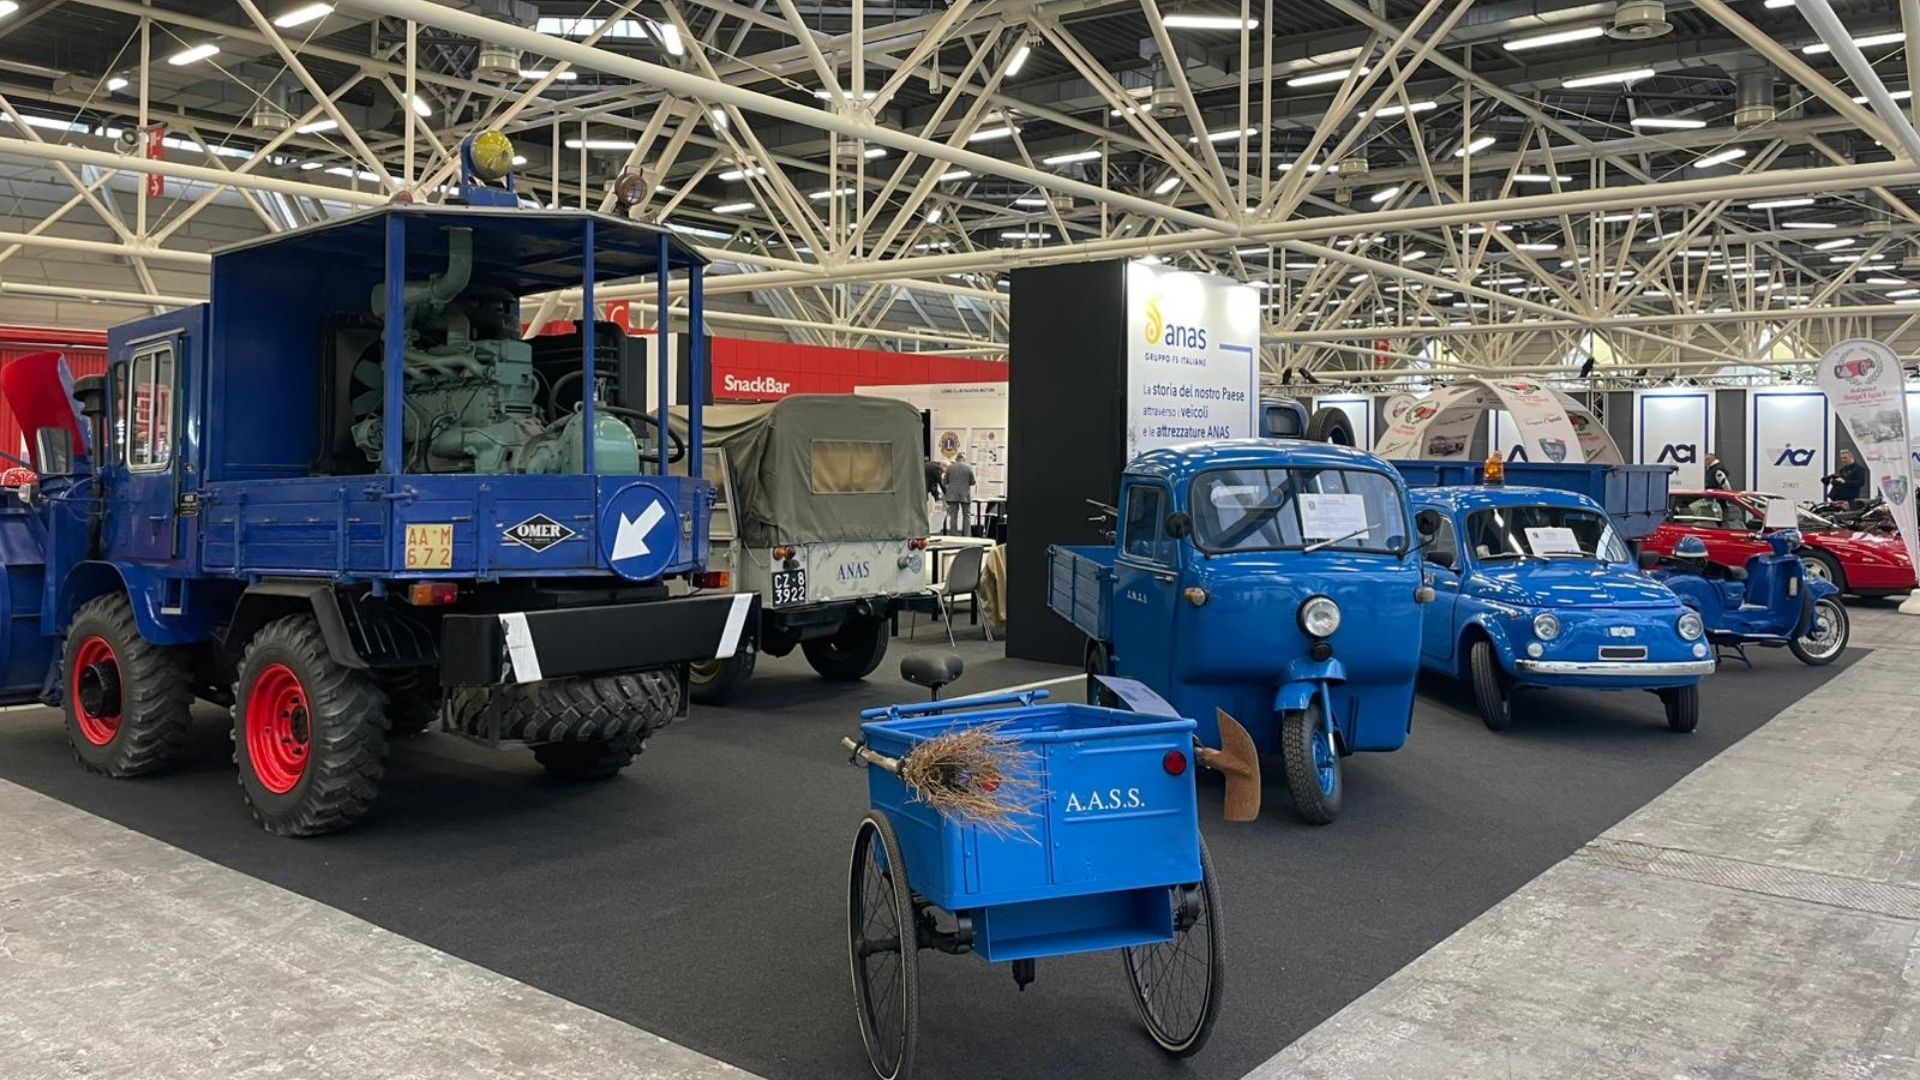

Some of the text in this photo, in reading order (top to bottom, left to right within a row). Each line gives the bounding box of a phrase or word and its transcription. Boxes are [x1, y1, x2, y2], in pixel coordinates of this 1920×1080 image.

[1164, 324, 1207, 350] anas
[1144, 353, 1170, 363] GRUPPO
[1181, 356, 1207, 367] ITALIANE
[724, 374, 790, 394] SnackBar
[1143, 383, 1245, 402] La storia del nostro Paese
[1143, 406, 1176, 417] attraverso
[1181, 404, 1209, 419] veicoli
[1143, 429, 1148, 437] e
[1157, 425, 1205, 439] attrezzature
[1207, 426, 1230, 440] ANAS
[1657, 443, 1696, 464] ACI
[408, 528, 451, 546] AA M
[517, 524, 561, 538] OMER
[837, 561, 871, 581] ANAS
[775, 586, 805, 604] 3922
[1065, 787, 1146, 812] A.A.S.S.
